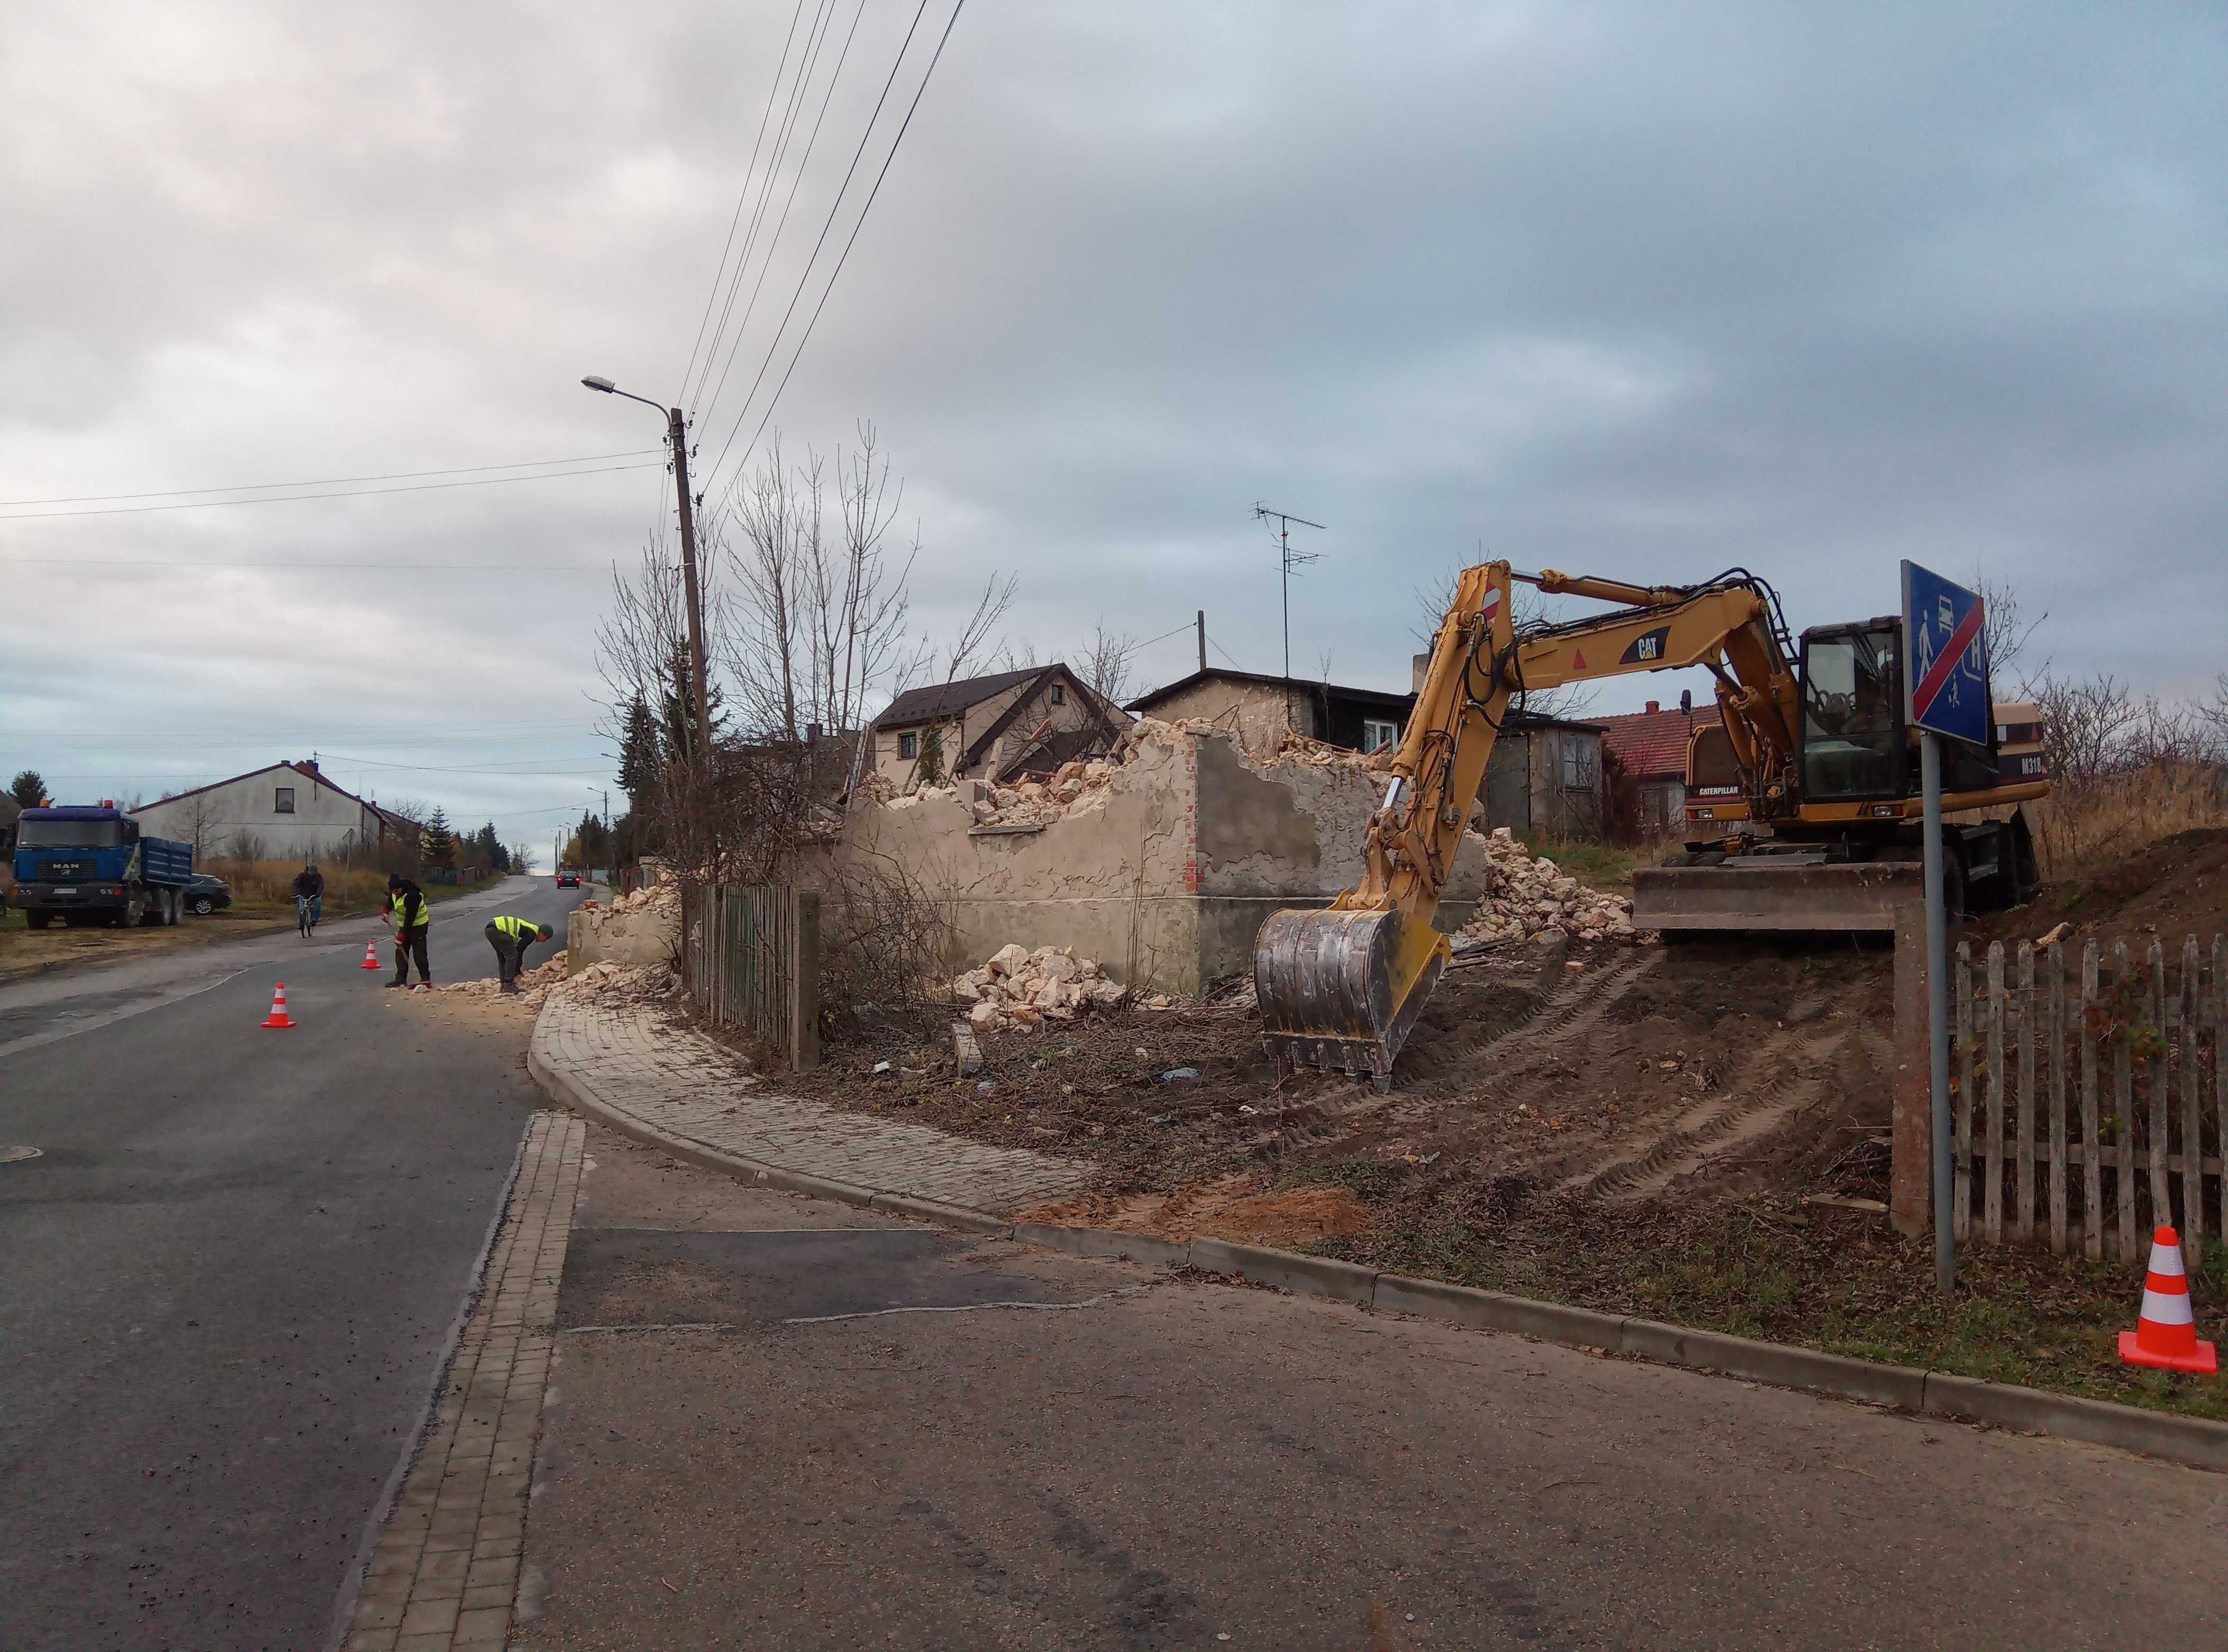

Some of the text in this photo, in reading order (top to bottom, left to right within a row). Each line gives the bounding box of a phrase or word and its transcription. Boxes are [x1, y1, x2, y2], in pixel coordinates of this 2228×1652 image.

[1638, 637, 1657, 659] CAT
[2022, 757, 2042, 775] M318
[1699, 786, 1738, 795] CATERPILLAR
